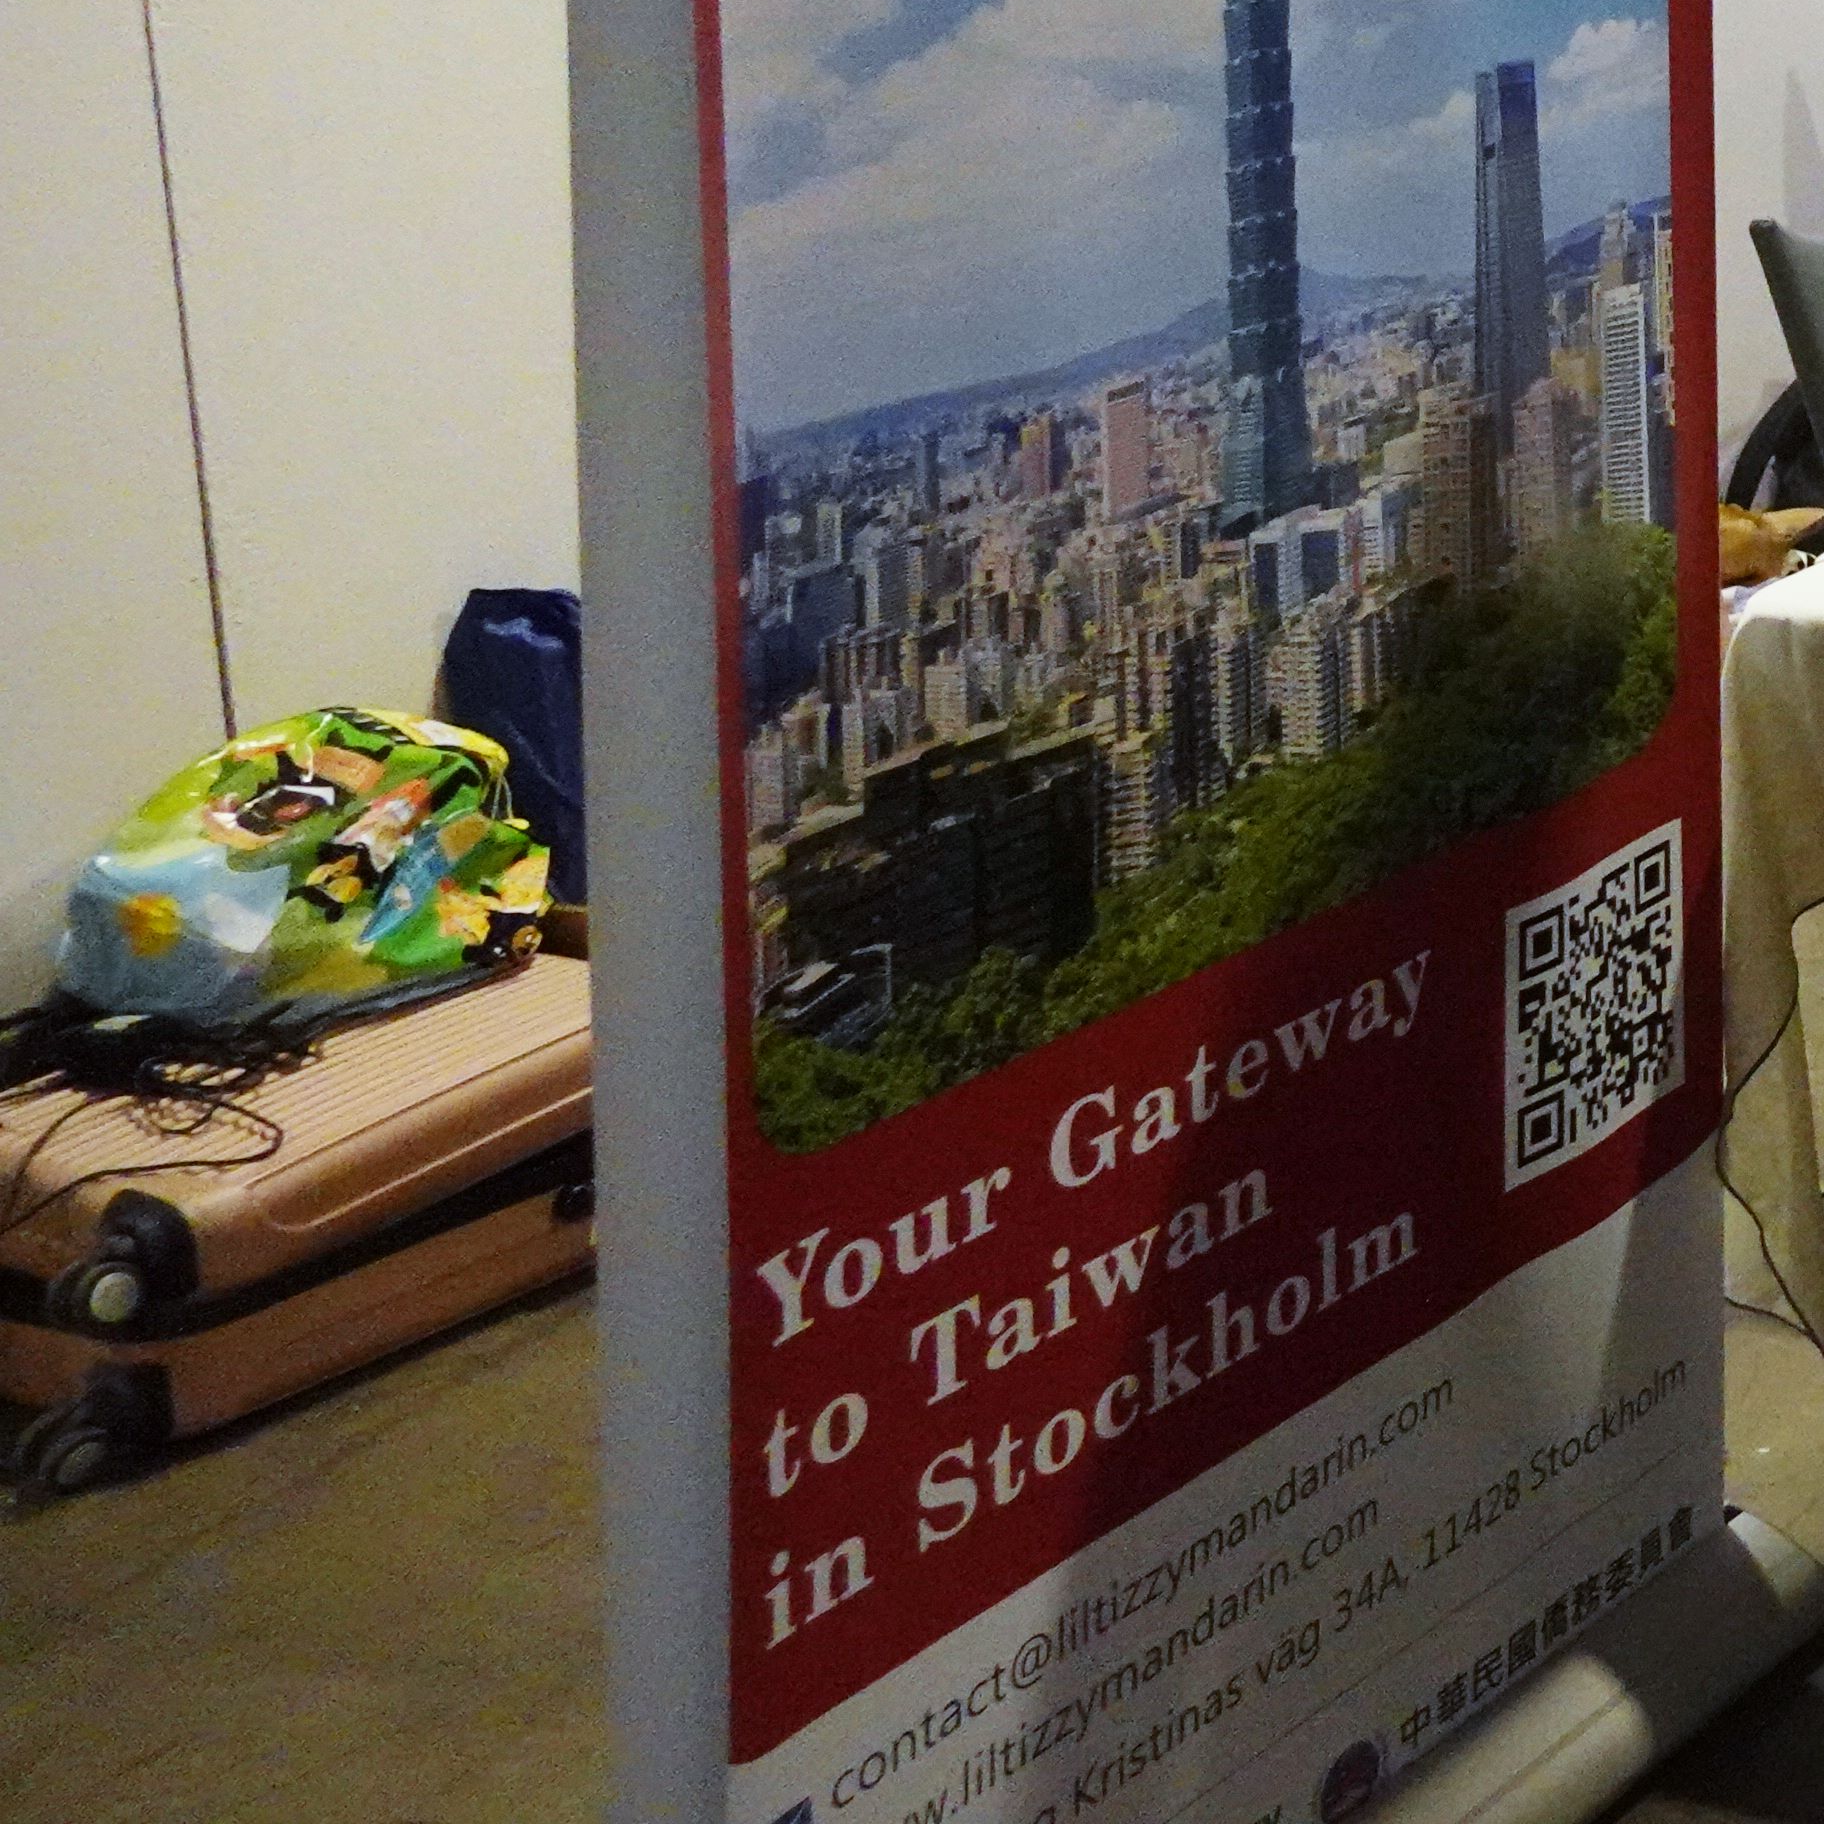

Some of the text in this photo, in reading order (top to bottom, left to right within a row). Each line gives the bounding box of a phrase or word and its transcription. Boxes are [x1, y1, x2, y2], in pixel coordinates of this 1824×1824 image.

[755, 949, 1433, 1351] Your Gateway
[763, 1166, 1274, 1498] to Taiwan
[764, 1206, 1421, 1650] in Stockholm
[831, 1376, 1454, 1808] contact@liltizzymandarin.com
[1073, 1674, 1244, 1816] Kristinas
[1256, 1617, 1321, 1684] väg
[1421, 1469, 1522, 1571] 11428
[1530, 1358, 1687, 1492] Stockholm
[1400, 1504, 1694, 1748] 中華民國僑務委員會
